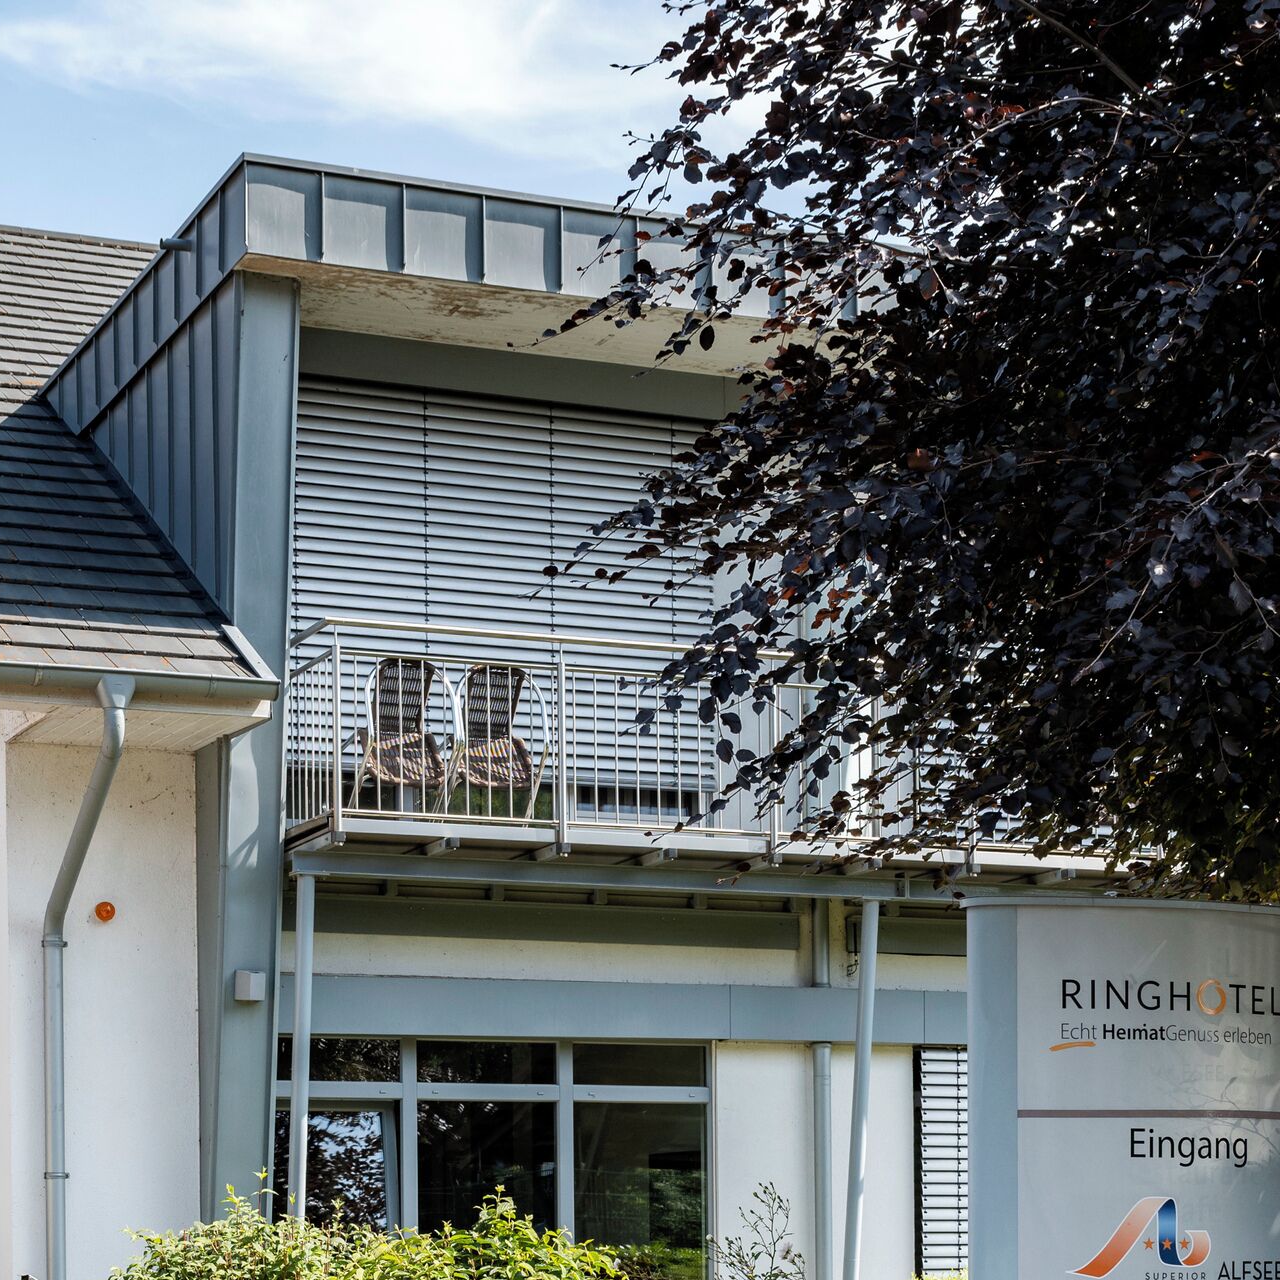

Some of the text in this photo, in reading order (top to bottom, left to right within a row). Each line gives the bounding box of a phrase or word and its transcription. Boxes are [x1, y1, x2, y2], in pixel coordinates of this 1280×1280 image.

[1060, 1023, 1097, 1041] Echt
[1223, 1027, 1272, 1046] erleben
[1129, 1128, 1249, 1168] Eingang
[1145, 1272, 1207, 1280] SUPERIOR
